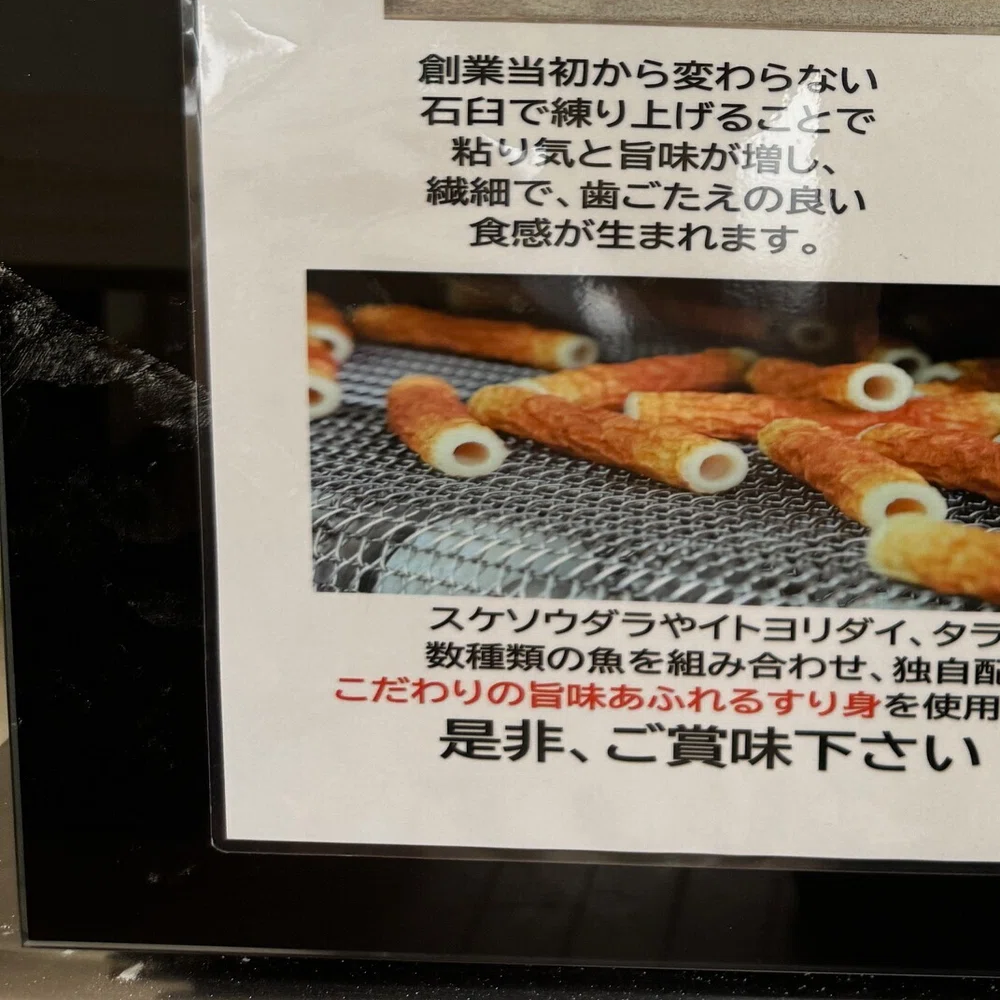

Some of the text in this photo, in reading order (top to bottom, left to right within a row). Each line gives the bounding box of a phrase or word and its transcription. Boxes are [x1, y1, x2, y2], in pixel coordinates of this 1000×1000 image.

[418, 53, 877, 94] 創業当初から変わらない
[420, 95, 875, 135] 石臼で練り上げることで
[452, 136, 836, 175] 粘り気と旨味が増し、
[426, 175, 867, 216] 繊細で、歯ごたえの良い
[469, 217, 817, 255] 食感が生まれます。
